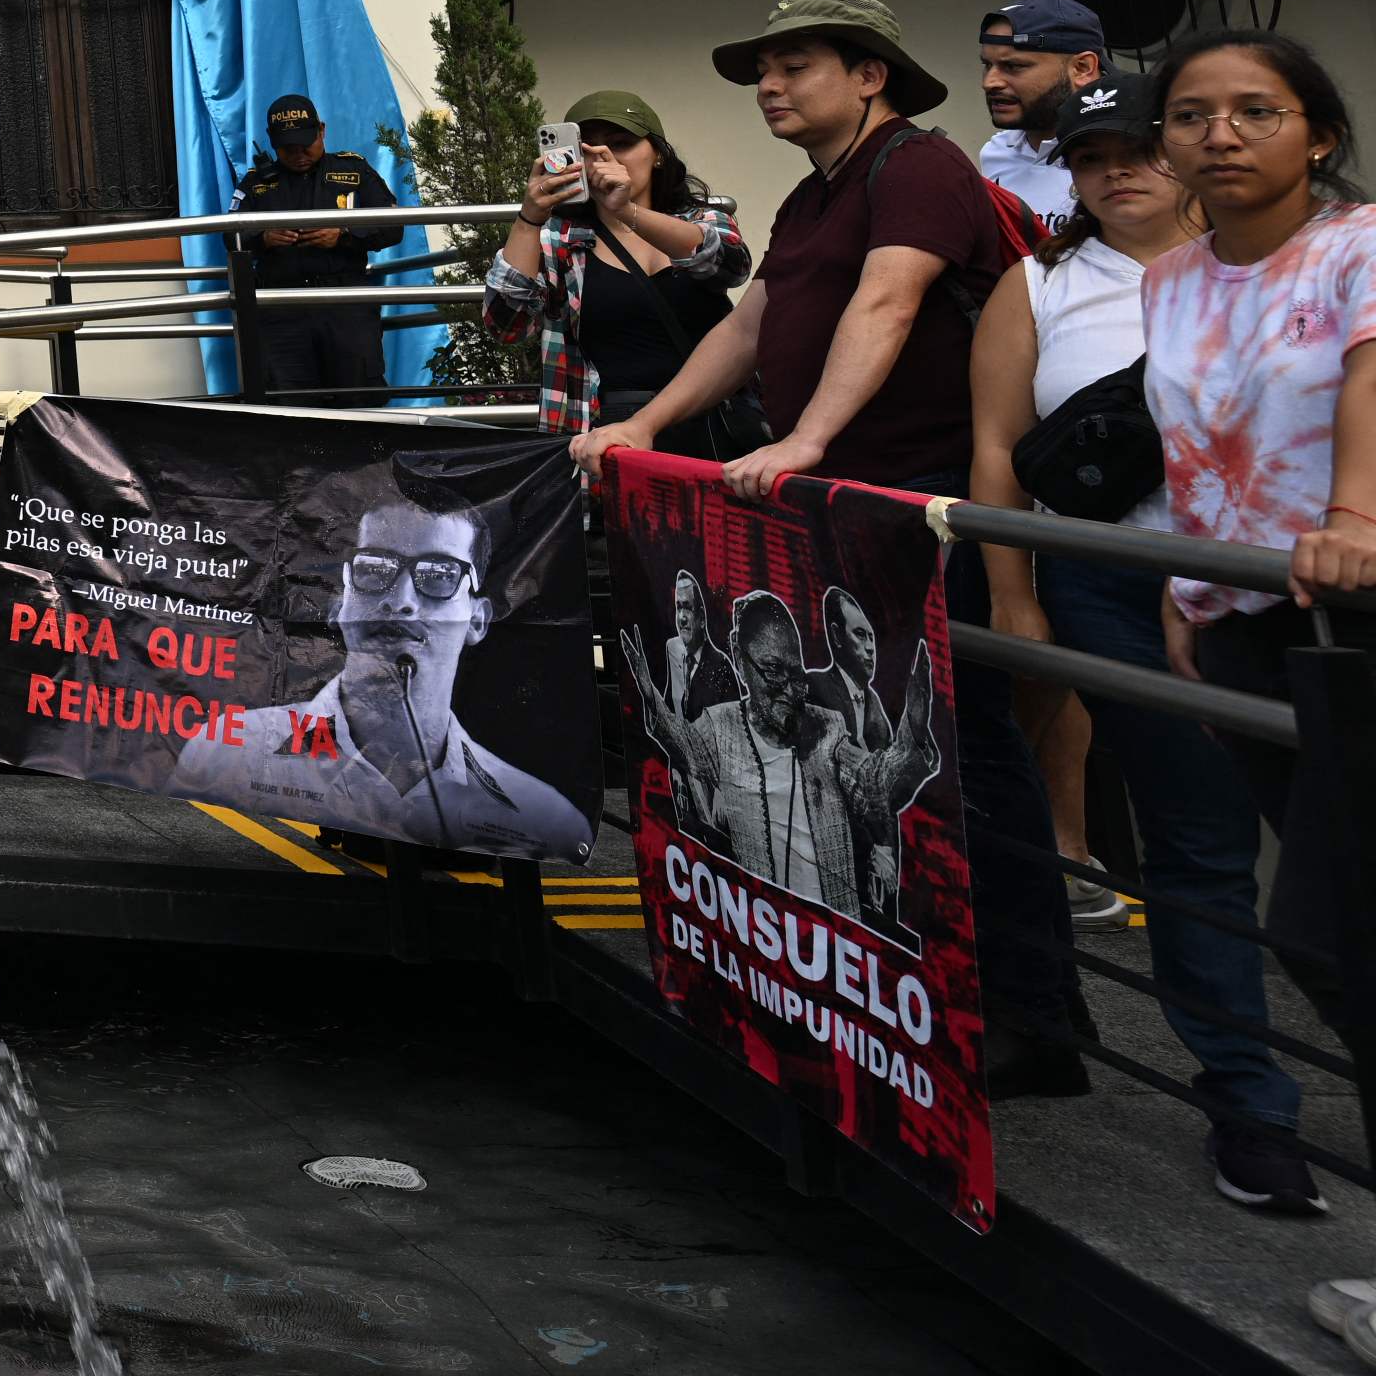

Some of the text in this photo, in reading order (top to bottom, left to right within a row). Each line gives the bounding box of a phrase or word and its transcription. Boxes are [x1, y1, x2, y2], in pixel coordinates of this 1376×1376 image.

[271, 110, 309, 123] POLICIA
[1080, 101, 1116, 114] adidas
[80, 512, 105, 528] se
[111, 517, 187, 546] ponga
[195, 521, 226, 545] las
[5, 528, 249, 579] pilas esa vieja puta!”
[163, 595, 254, 625] Martínez
[9, 602, 238, 680] PARA QUE
[27, 673, 340, 761] RENUNCIE YA
[250, 780, 325, 802] MIGUEL MARTINEZ
[665, 844, 932, 1045] CONSUELO
[672, 912, 934, 1109] DE LA IMPUNIDAD
